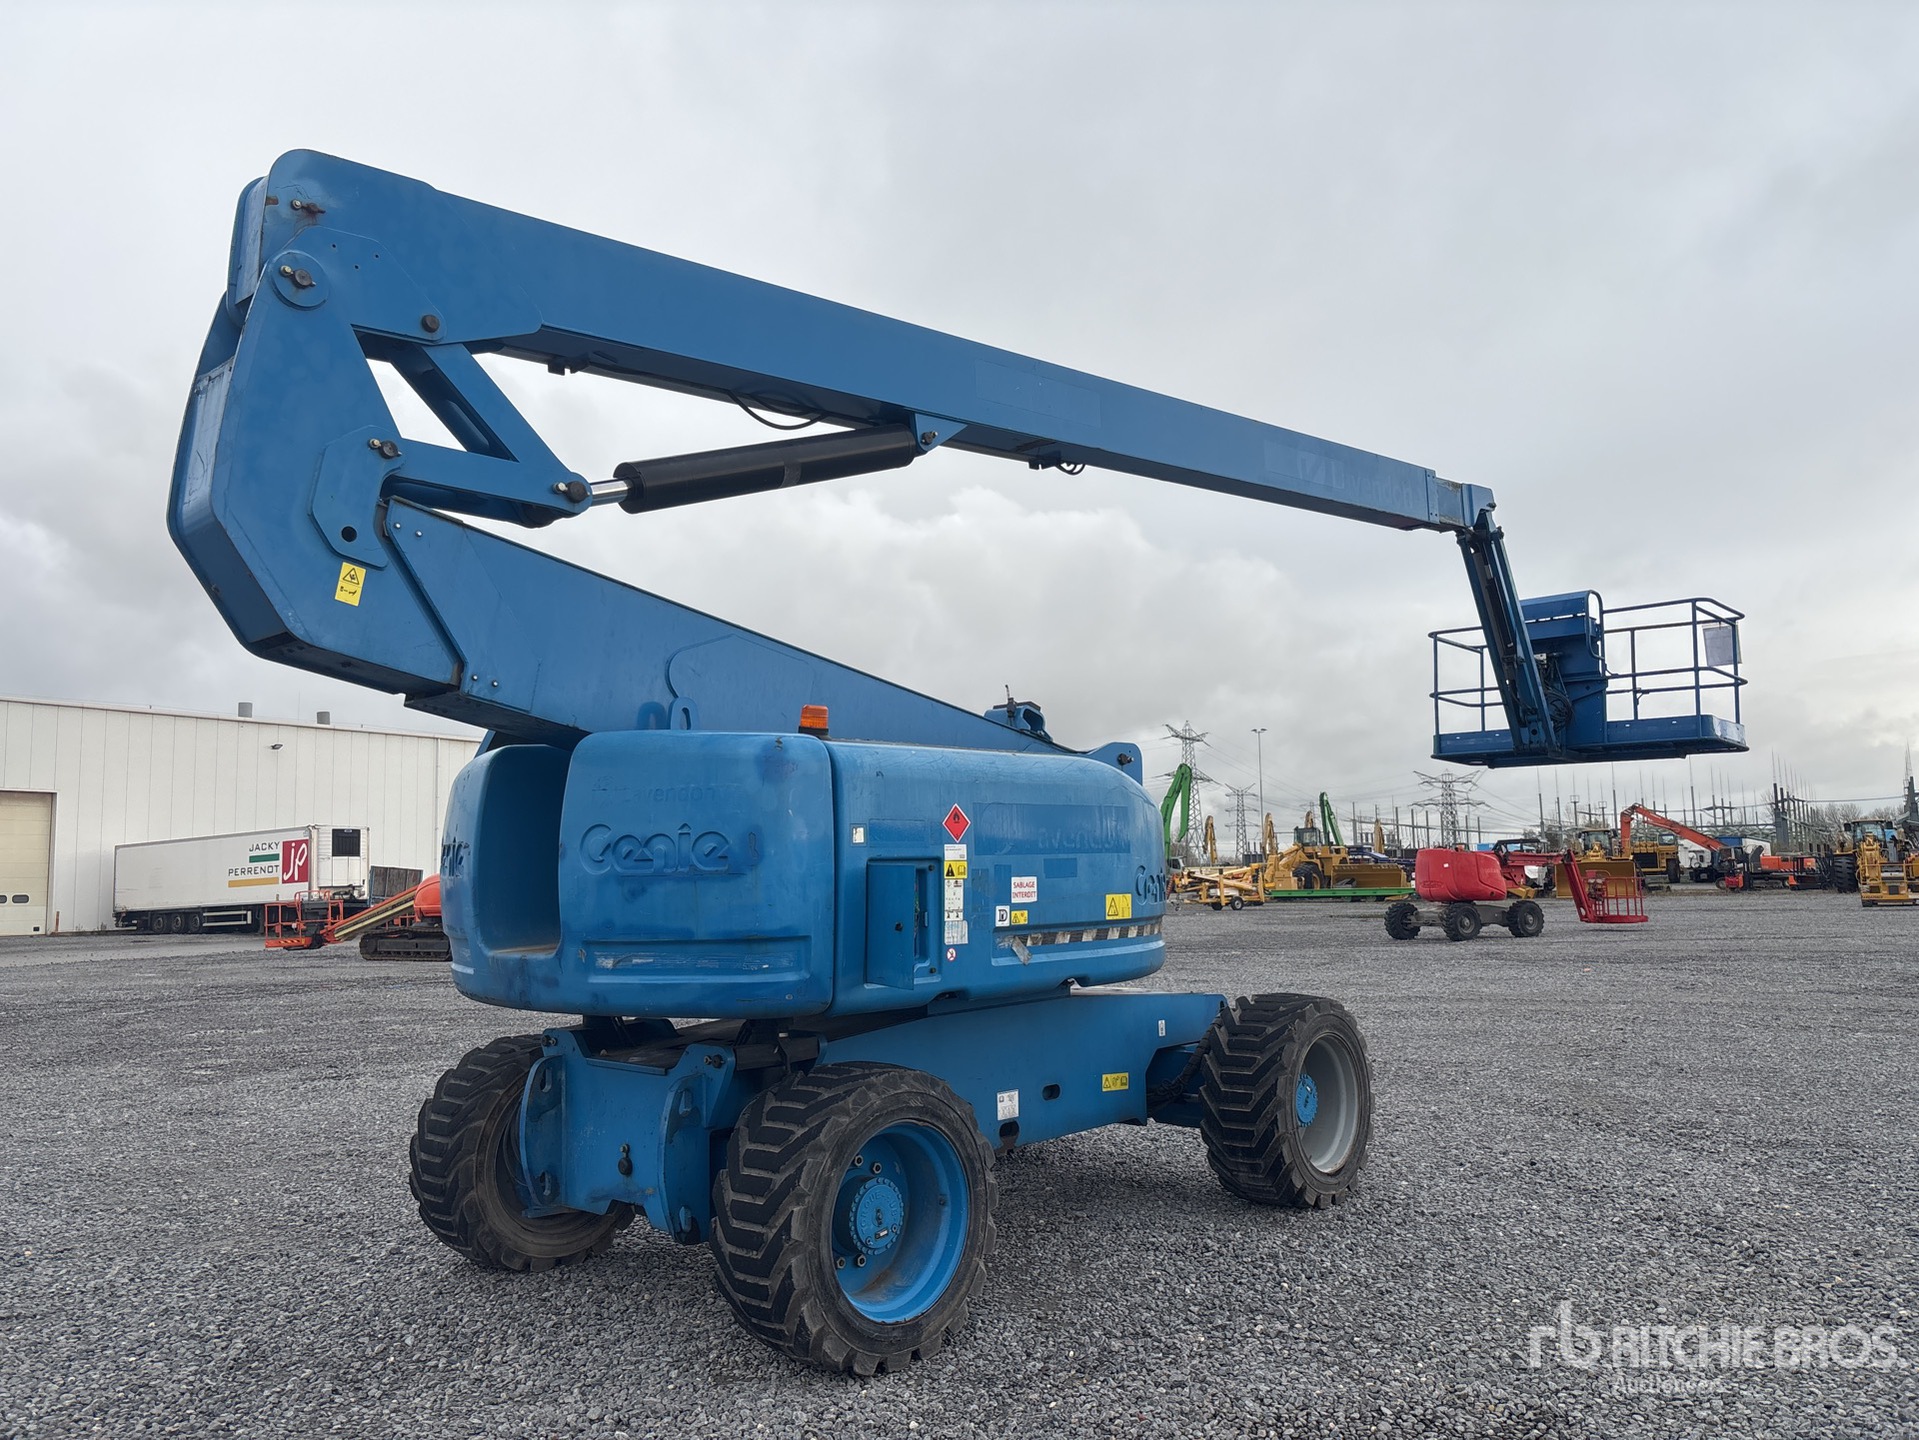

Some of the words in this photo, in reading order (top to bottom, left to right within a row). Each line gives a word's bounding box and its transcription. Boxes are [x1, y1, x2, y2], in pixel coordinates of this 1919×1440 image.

[249, 841, 280, 852] JACKY
[441, 823, 470, 878] enie
[579, 822, 731, 875] Genie
[228, 865, 279, 876] PERRENOT
[1013, 881, 1035, 889] SABLAGE
[1012, 890, 1036, 899] INTERDIT
